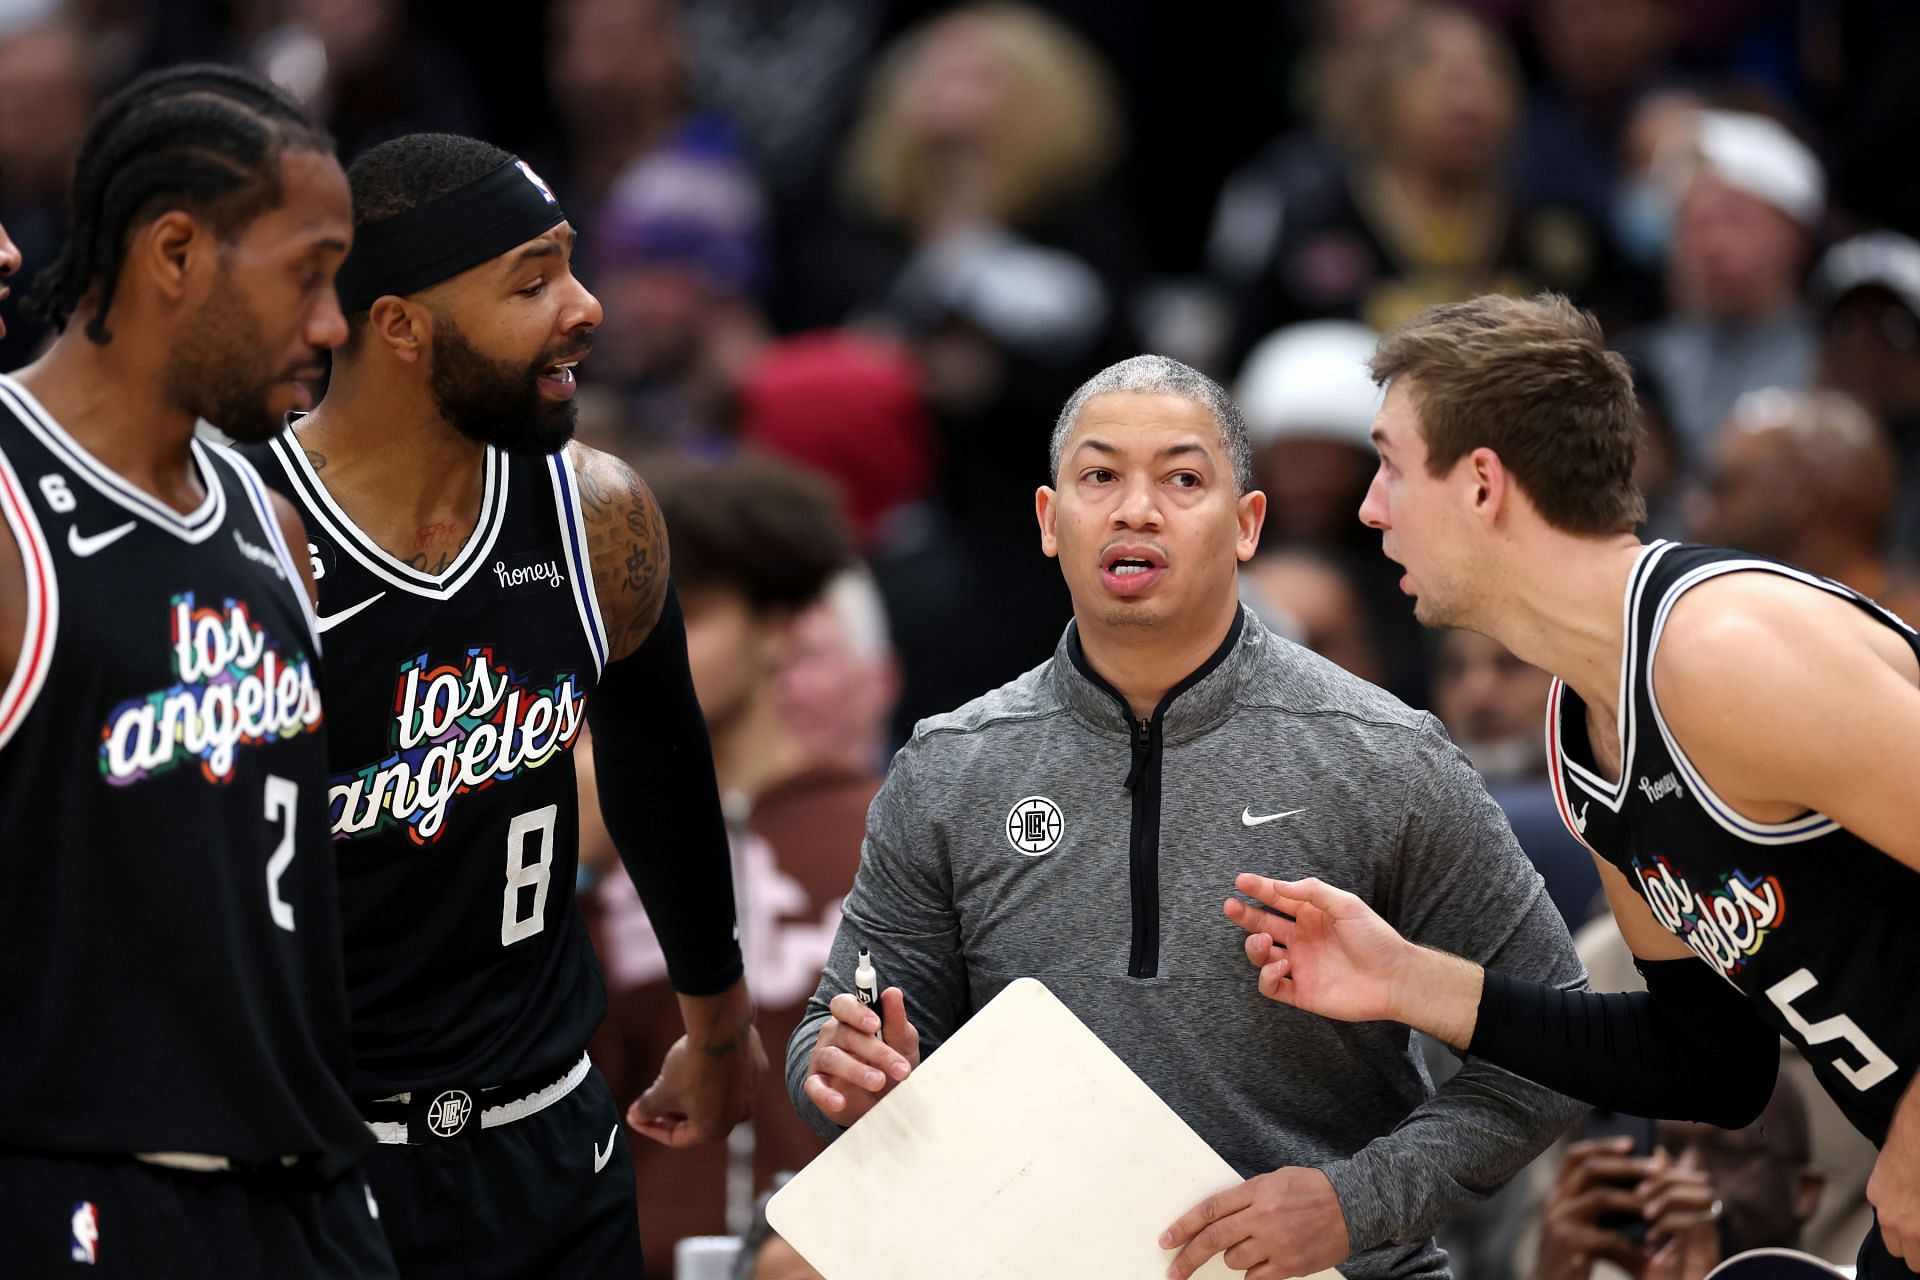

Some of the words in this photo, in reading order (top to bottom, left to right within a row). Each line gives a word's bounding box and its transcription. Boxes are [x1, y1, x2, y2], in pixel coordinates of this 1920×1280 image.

[38, 473, 77, 513] 6
[493, 560, 565, 589] honey
[175, 600, 264, 683] los
[107, 650, 322, 777] angeles
[396, 656, 508, 750] los
[328, 681, 584, 838] angeles
[1638, 771, 1683, 803] honey
[501, 803, 557, 947] 8
[1764, 967, 1900, 1092] 5
